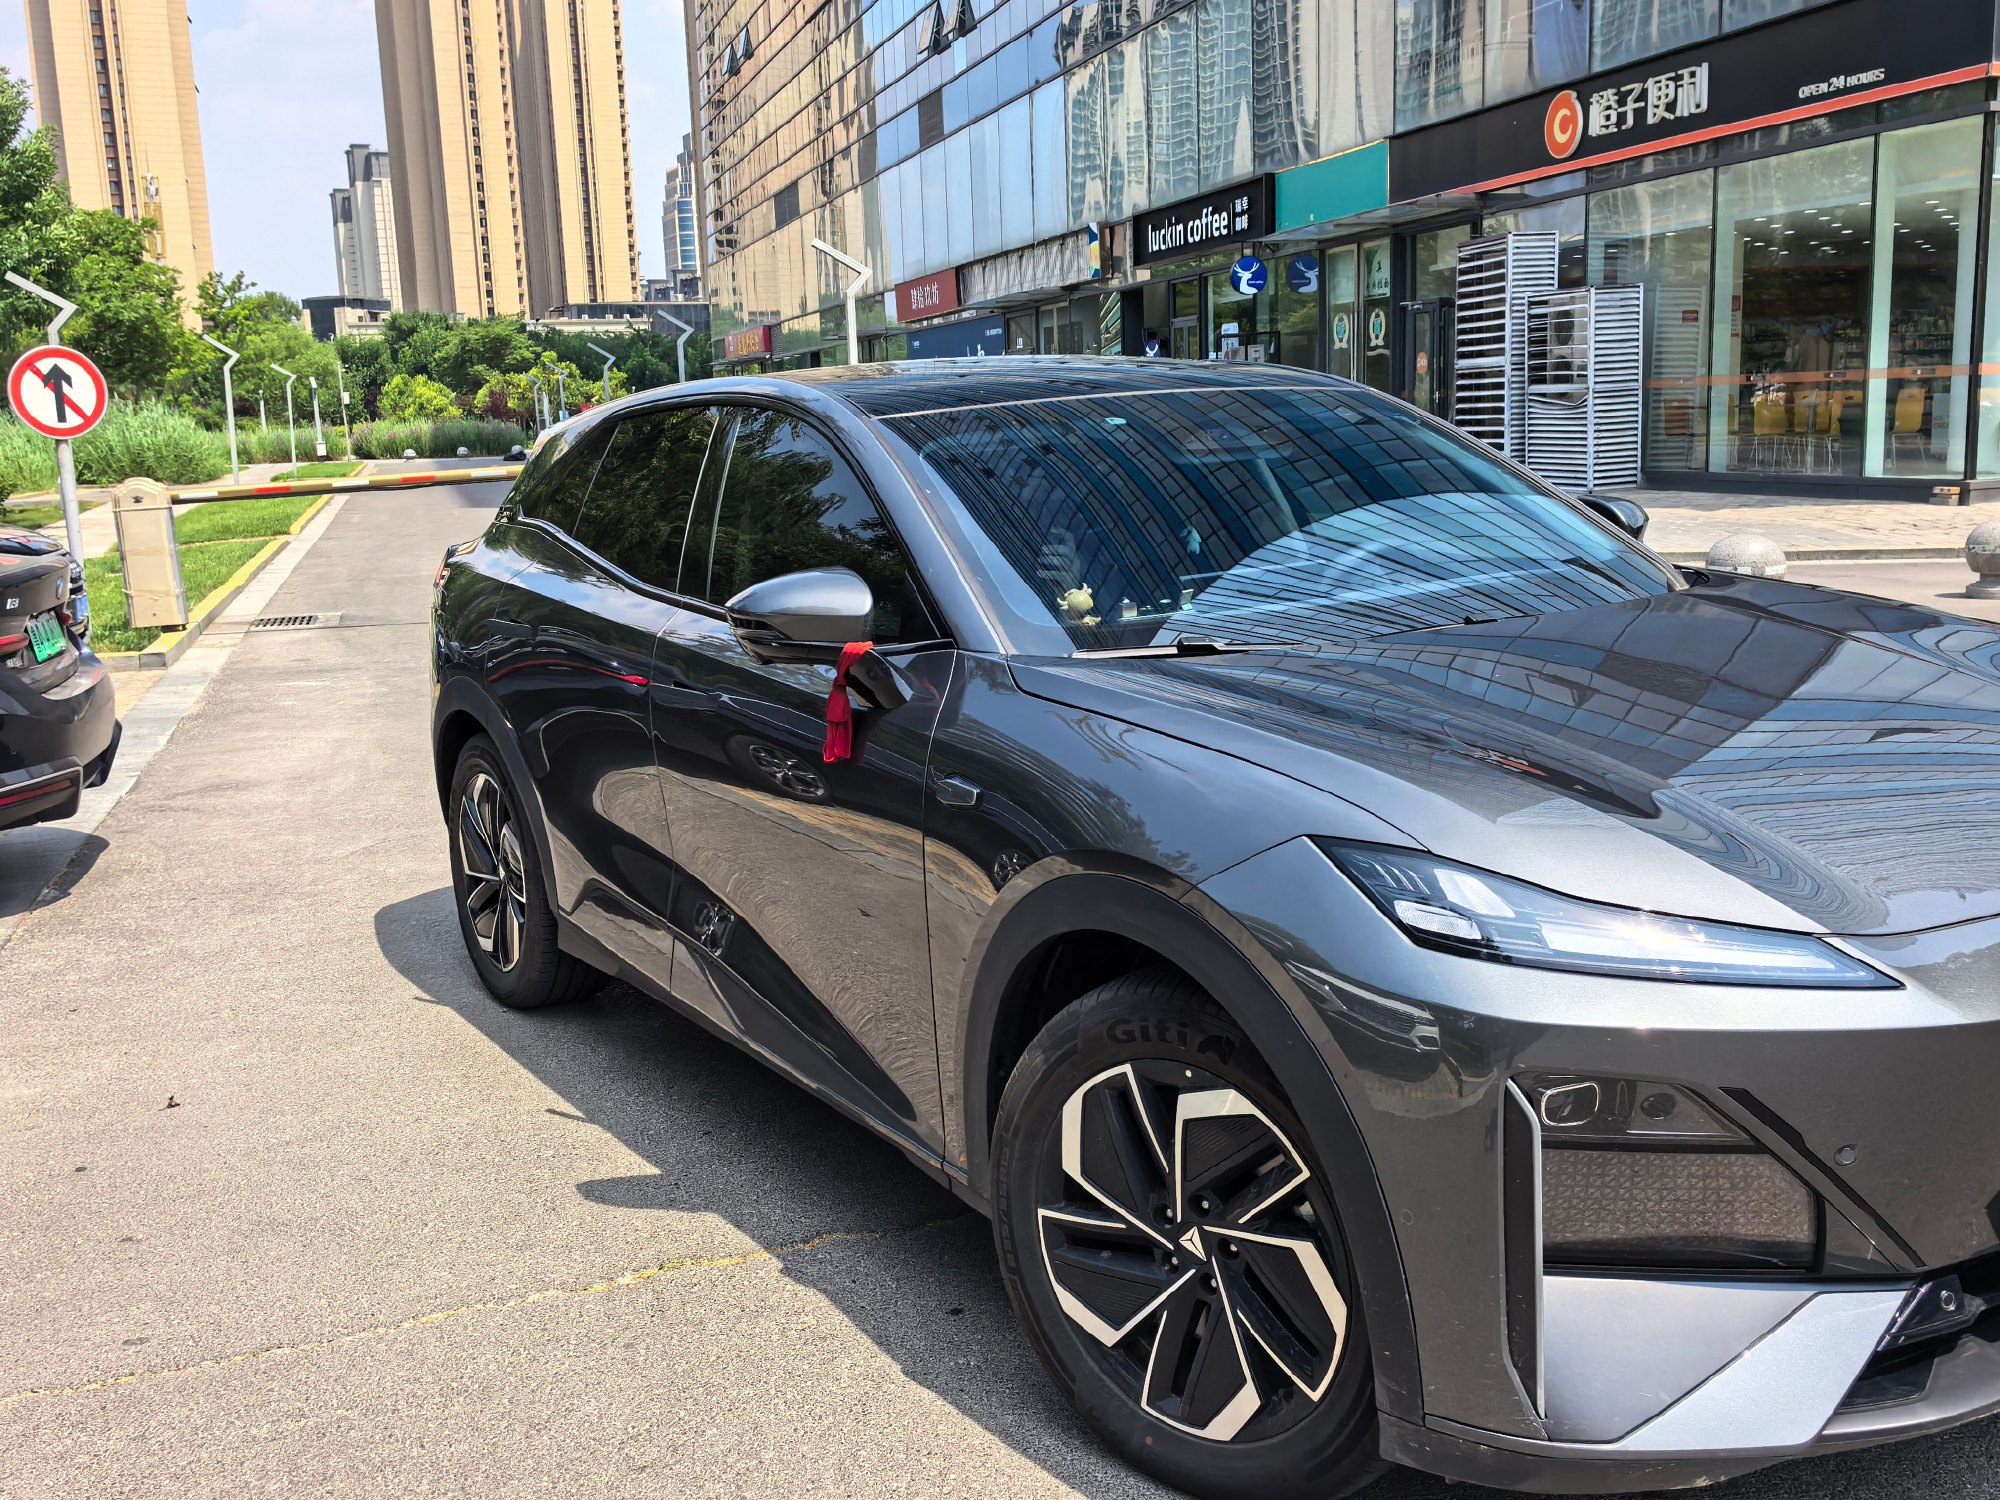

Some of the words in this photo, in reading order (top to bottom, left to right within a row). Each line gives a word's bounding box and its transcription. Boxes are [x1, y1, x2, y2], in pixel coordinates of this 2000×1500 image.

[1588, 62, 1710, 137] 橙子便利
[1798, 82, 1829, 98] OPEN
[1829, 75, 1846, 91] 24
[1846, 68, 1885, 87] HOURS
[1148, 216, 1184, 252] luckin
[1187, 206, 1228, 243] coffee
[1106, 1017, 1189, 1050] Giti
